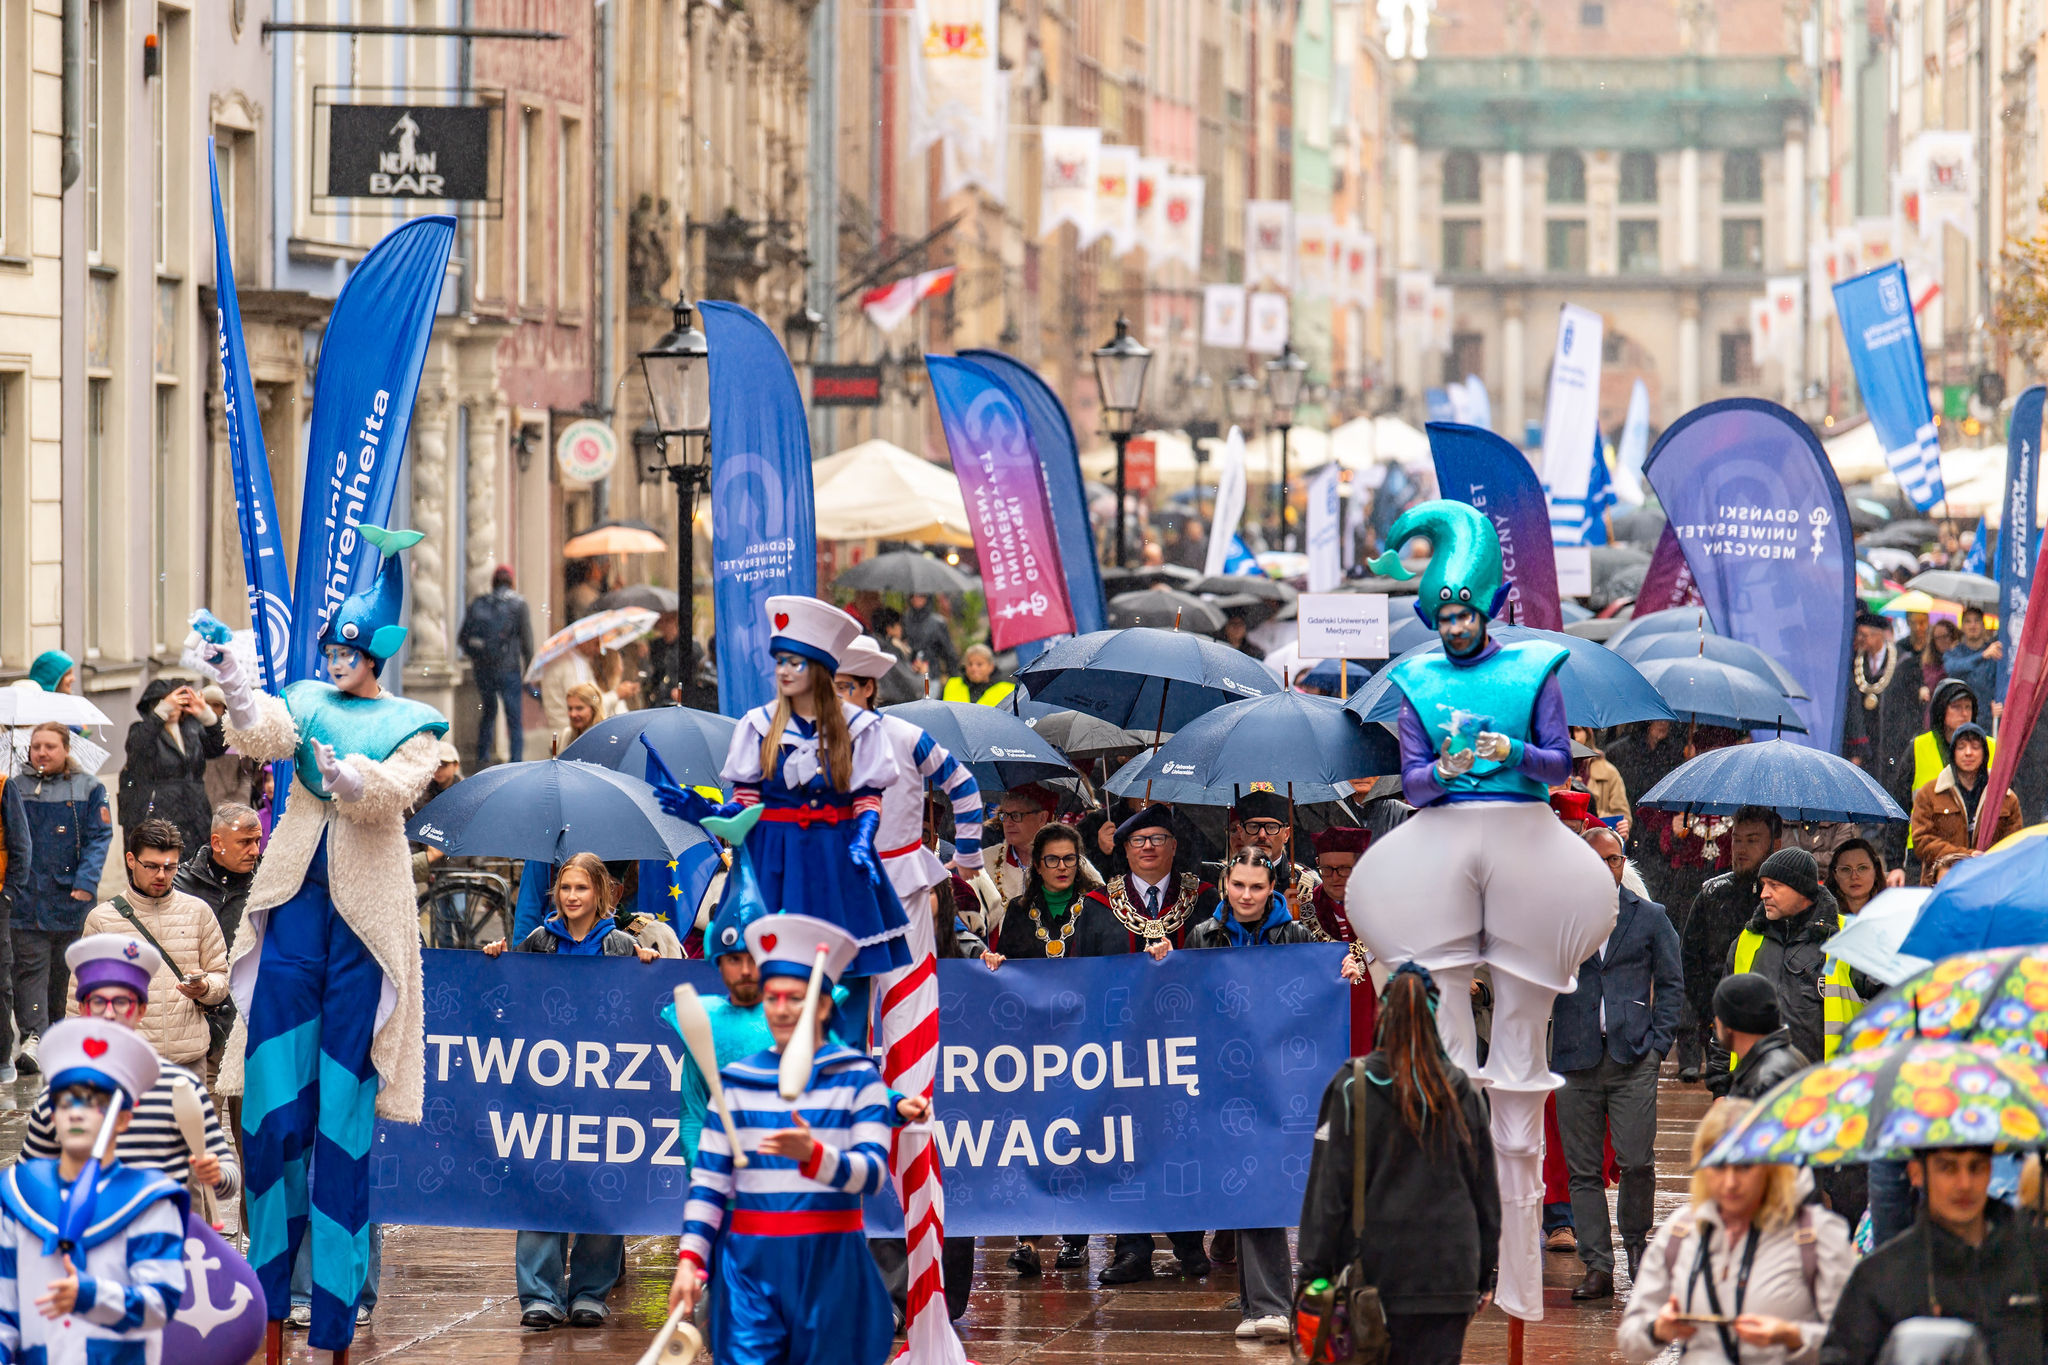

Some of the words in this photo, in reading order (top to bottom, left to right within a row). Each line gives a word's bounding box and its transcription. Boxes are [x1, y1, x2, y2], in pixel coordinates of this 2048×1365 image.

[370, 173, 445, 195] BAR
[326, 389, 390, 622] ahrenheita
[1307, 617, 1336, 625] Gdański
[1337, 617, 1379, 626] Uniwersytet
[1325, 627, 1362, 636] Medyczny
[426, 1034, 684, 1092] TWORZY
[872, 1036, 1200, 1097] ROPOLIĘ
[488, 1109, 686, 1166] WIEDZ
[934, 1115, 1136, 1167] WACJI
